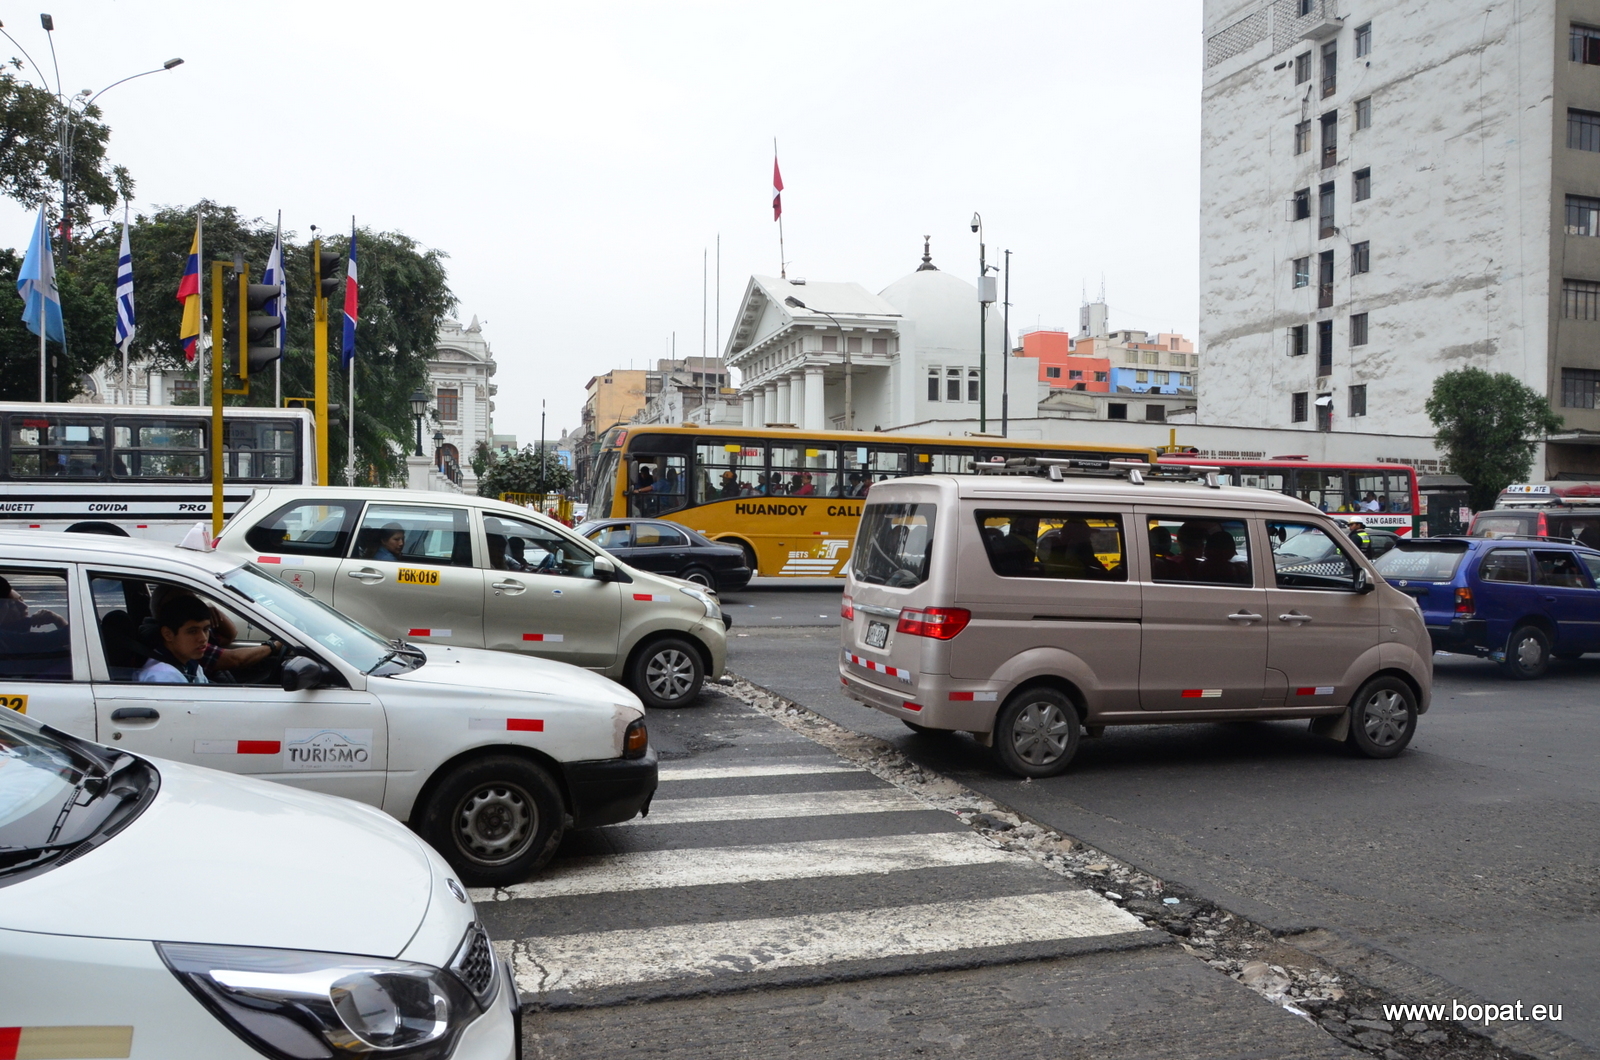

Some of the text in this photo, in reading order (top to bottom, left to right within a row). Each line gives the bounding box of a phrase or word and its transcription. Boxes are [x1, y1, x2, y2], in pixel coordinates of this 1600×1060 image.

[88, 503, 128, 512] COVIDA
[178, 503, 207, 512] PRO
[735, 503, 808, 516] HUANDOY
[1365, 517, 1407, 525] SAN GABRIEL
[288, 747, 369, 763] TURISMO
